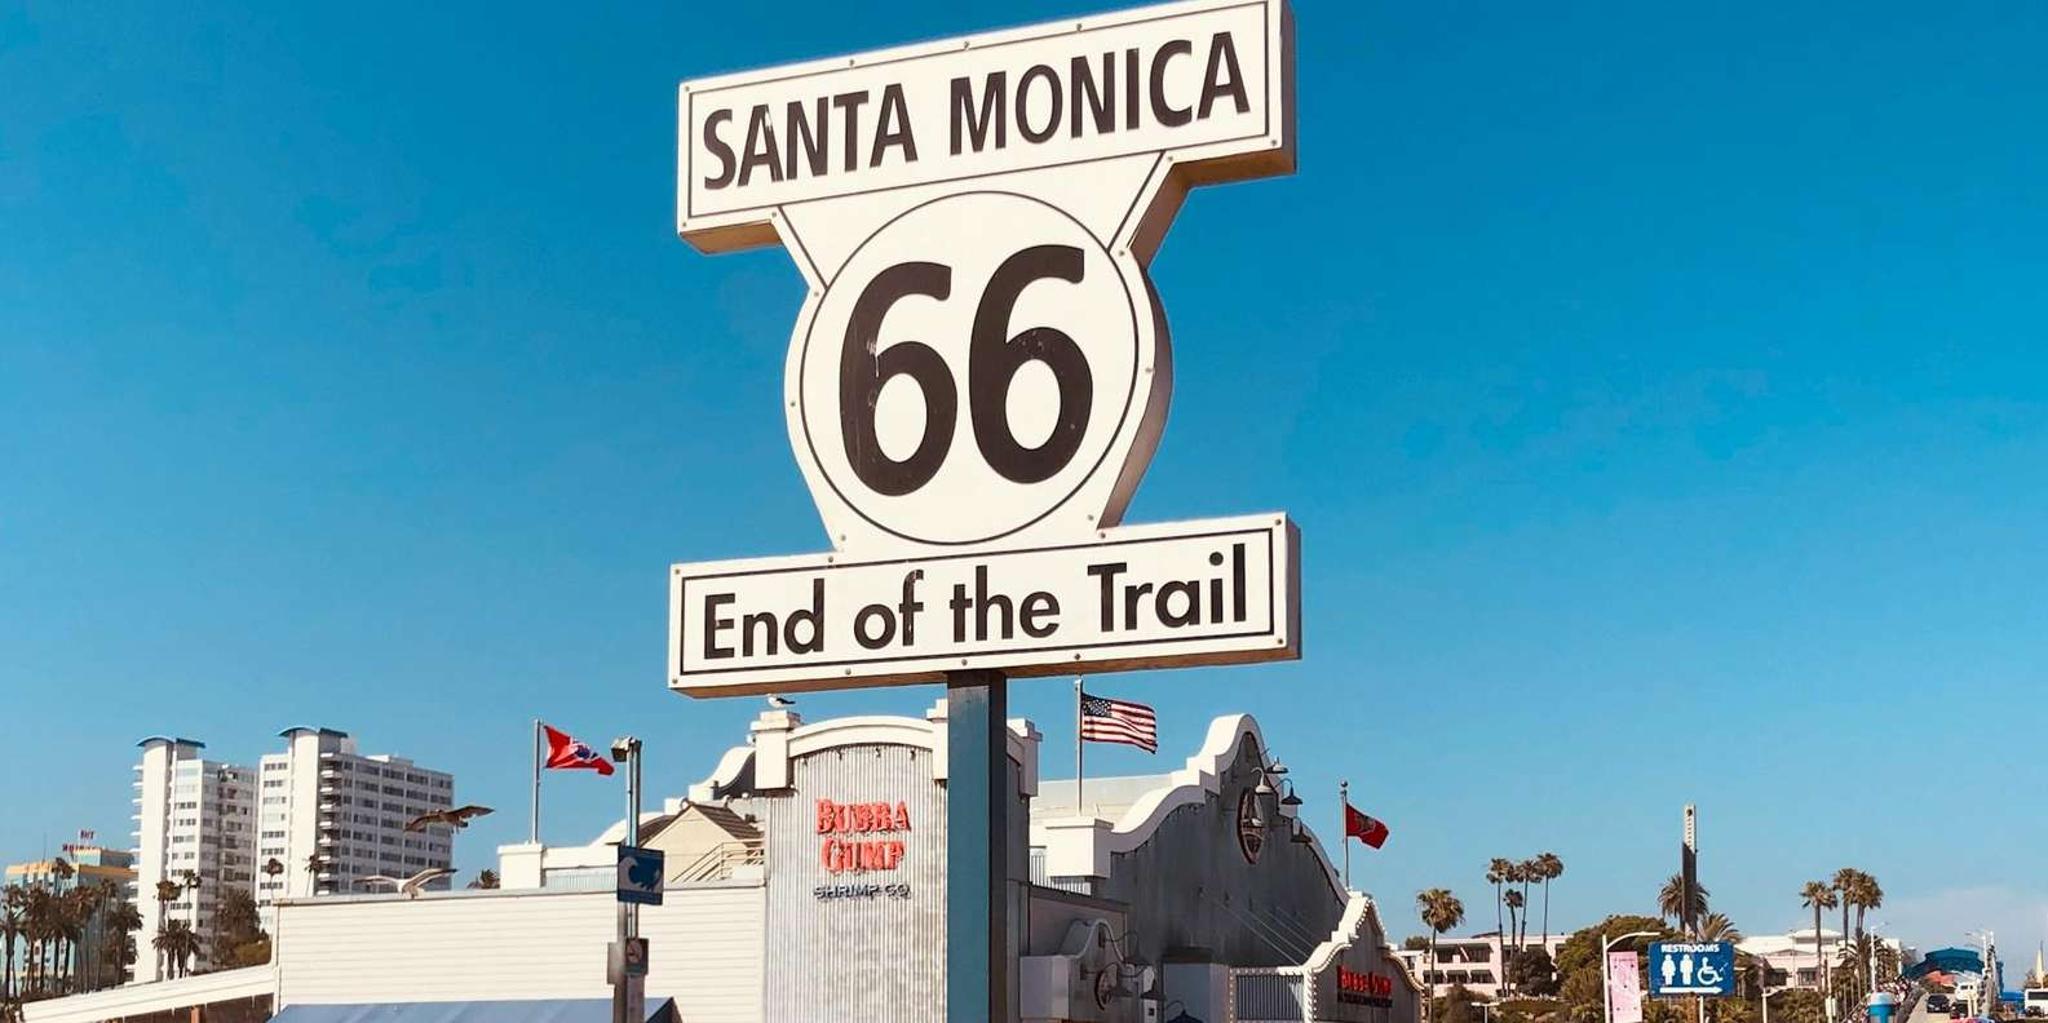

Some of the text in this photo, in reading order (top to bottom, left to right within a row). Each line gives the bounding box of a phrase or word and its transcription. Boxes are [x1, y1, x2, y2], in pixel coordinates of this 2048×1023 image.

[703, 31, 1251, 190] SANTA MONICA
[839, 244, 1093, 497] 66
[704, 543, 1246, 660] End of the Trail
[816, 798, 911, 834] BUBBA
[821, 837, 905, 874] GUMP
[814, 884, 881, 901] SHRIMP
[1661, 944, 1720, 953] RESTROOMS
